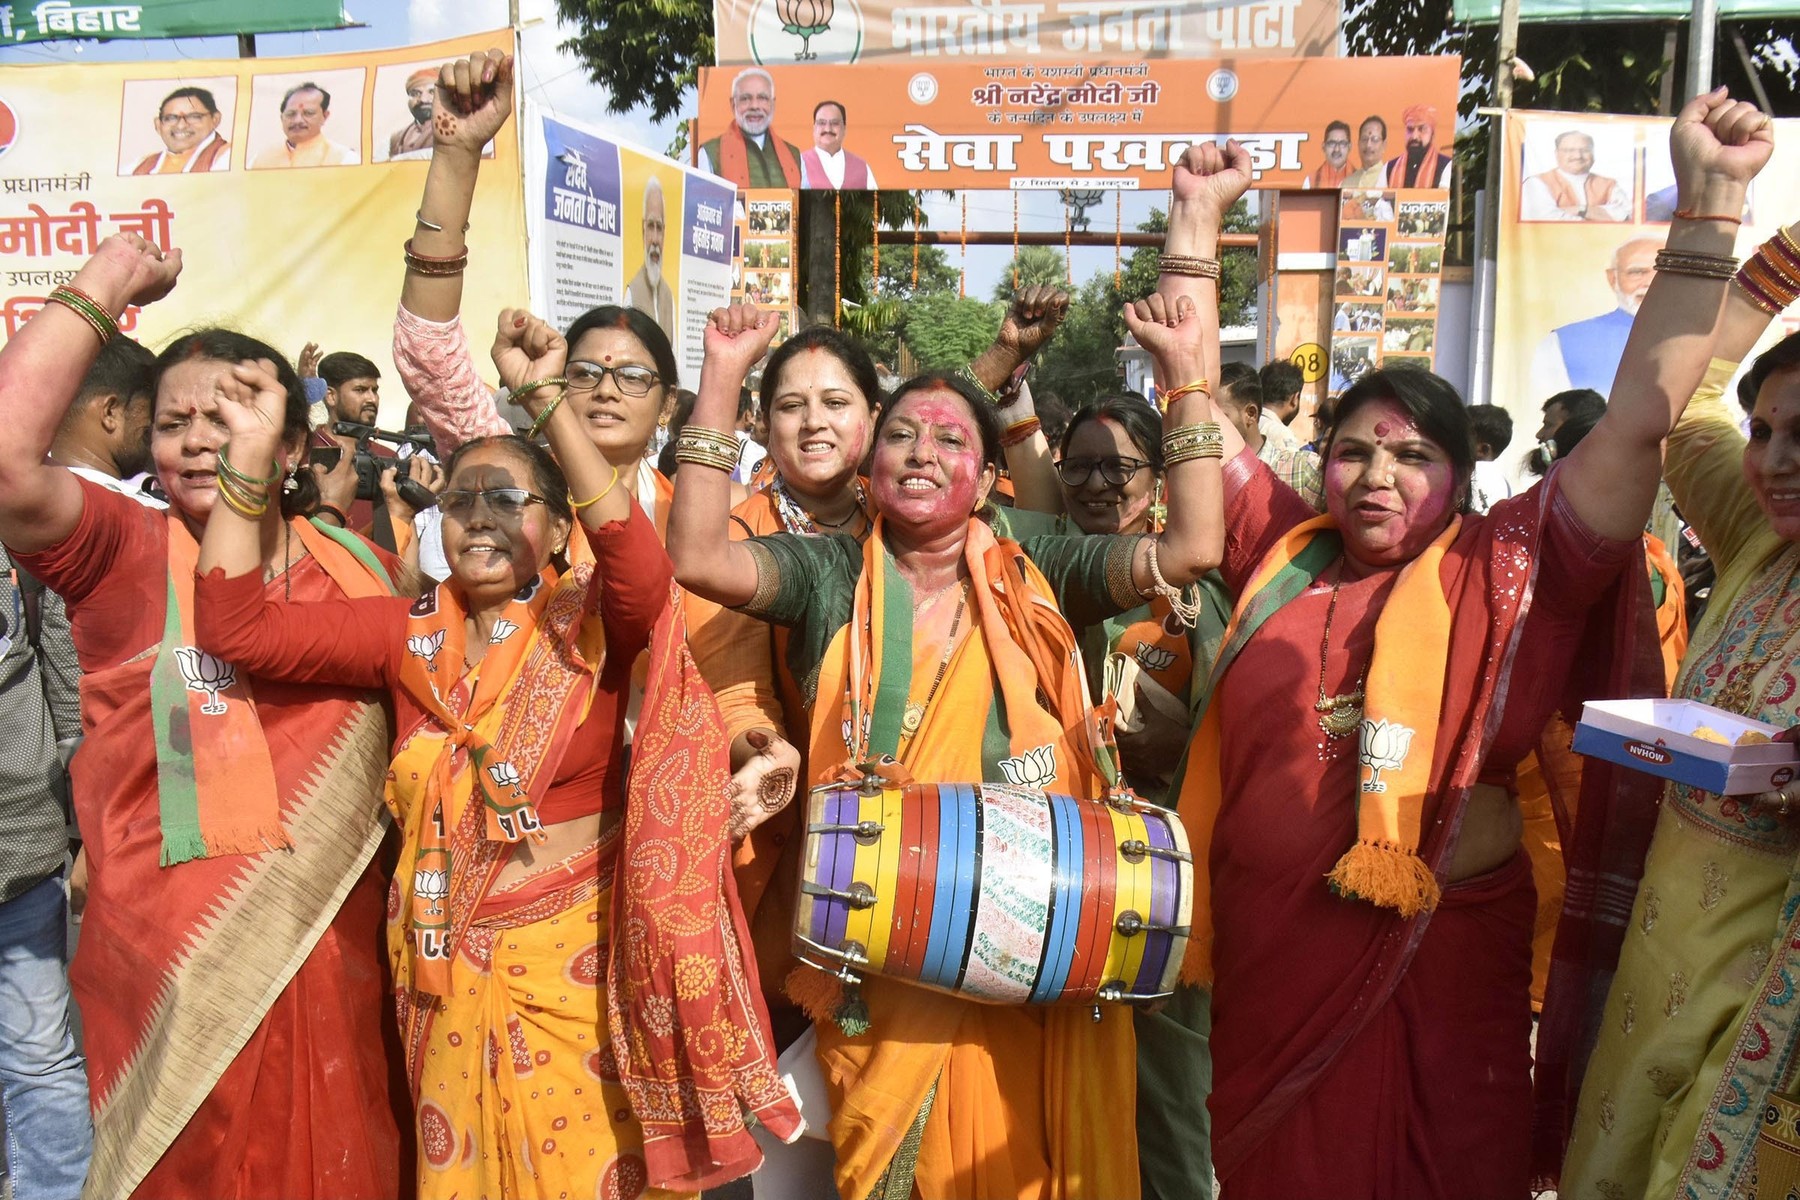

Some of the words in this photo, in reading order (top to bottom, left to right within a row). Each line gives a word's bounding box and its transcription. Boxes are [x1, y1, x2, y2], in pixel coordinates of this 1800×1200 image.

[31, 1, 142, 34] बिहार
[1057, 3, 1190, 52] जनता
[1204, 0, 1301, 48] पाटी
[984, 66, 1016, 78] भारत
[1021, 64, 1035, 77] के
[1040, 63, 1083, 78] यशस्वी
[1089, 62, 1148, 78] प्रधानमंत्री
[973, 82, 1004, 105] श्री
[1007, 83, 1063, 106] नरेंद्र
[1067, 83, 1123, 105] मोदी
[1127, 82, 1160, 105] जी
[987, 109, 1001, 123] के
[1005, 110, 1055, 125] जन्मदिन
[1059, 109, 1074, 123] के
[1079, 112, 1126, 125] उपलक्ष्य
[1131, 109, 1143, 123] में
[893, 124, 1022, 171] सेवा
[1042, 133, 1308, 180] पखड़ा
[3, 172, 92, 194] प्रधानमंत्री
[553, 186, 586, 226] जनता
[586, 186, 597, 227] के
[597, 199, 617, 233] साथ
[0, 201, 102, 257] मोदी
[1629, 745, 1664, 762] MOHAN
